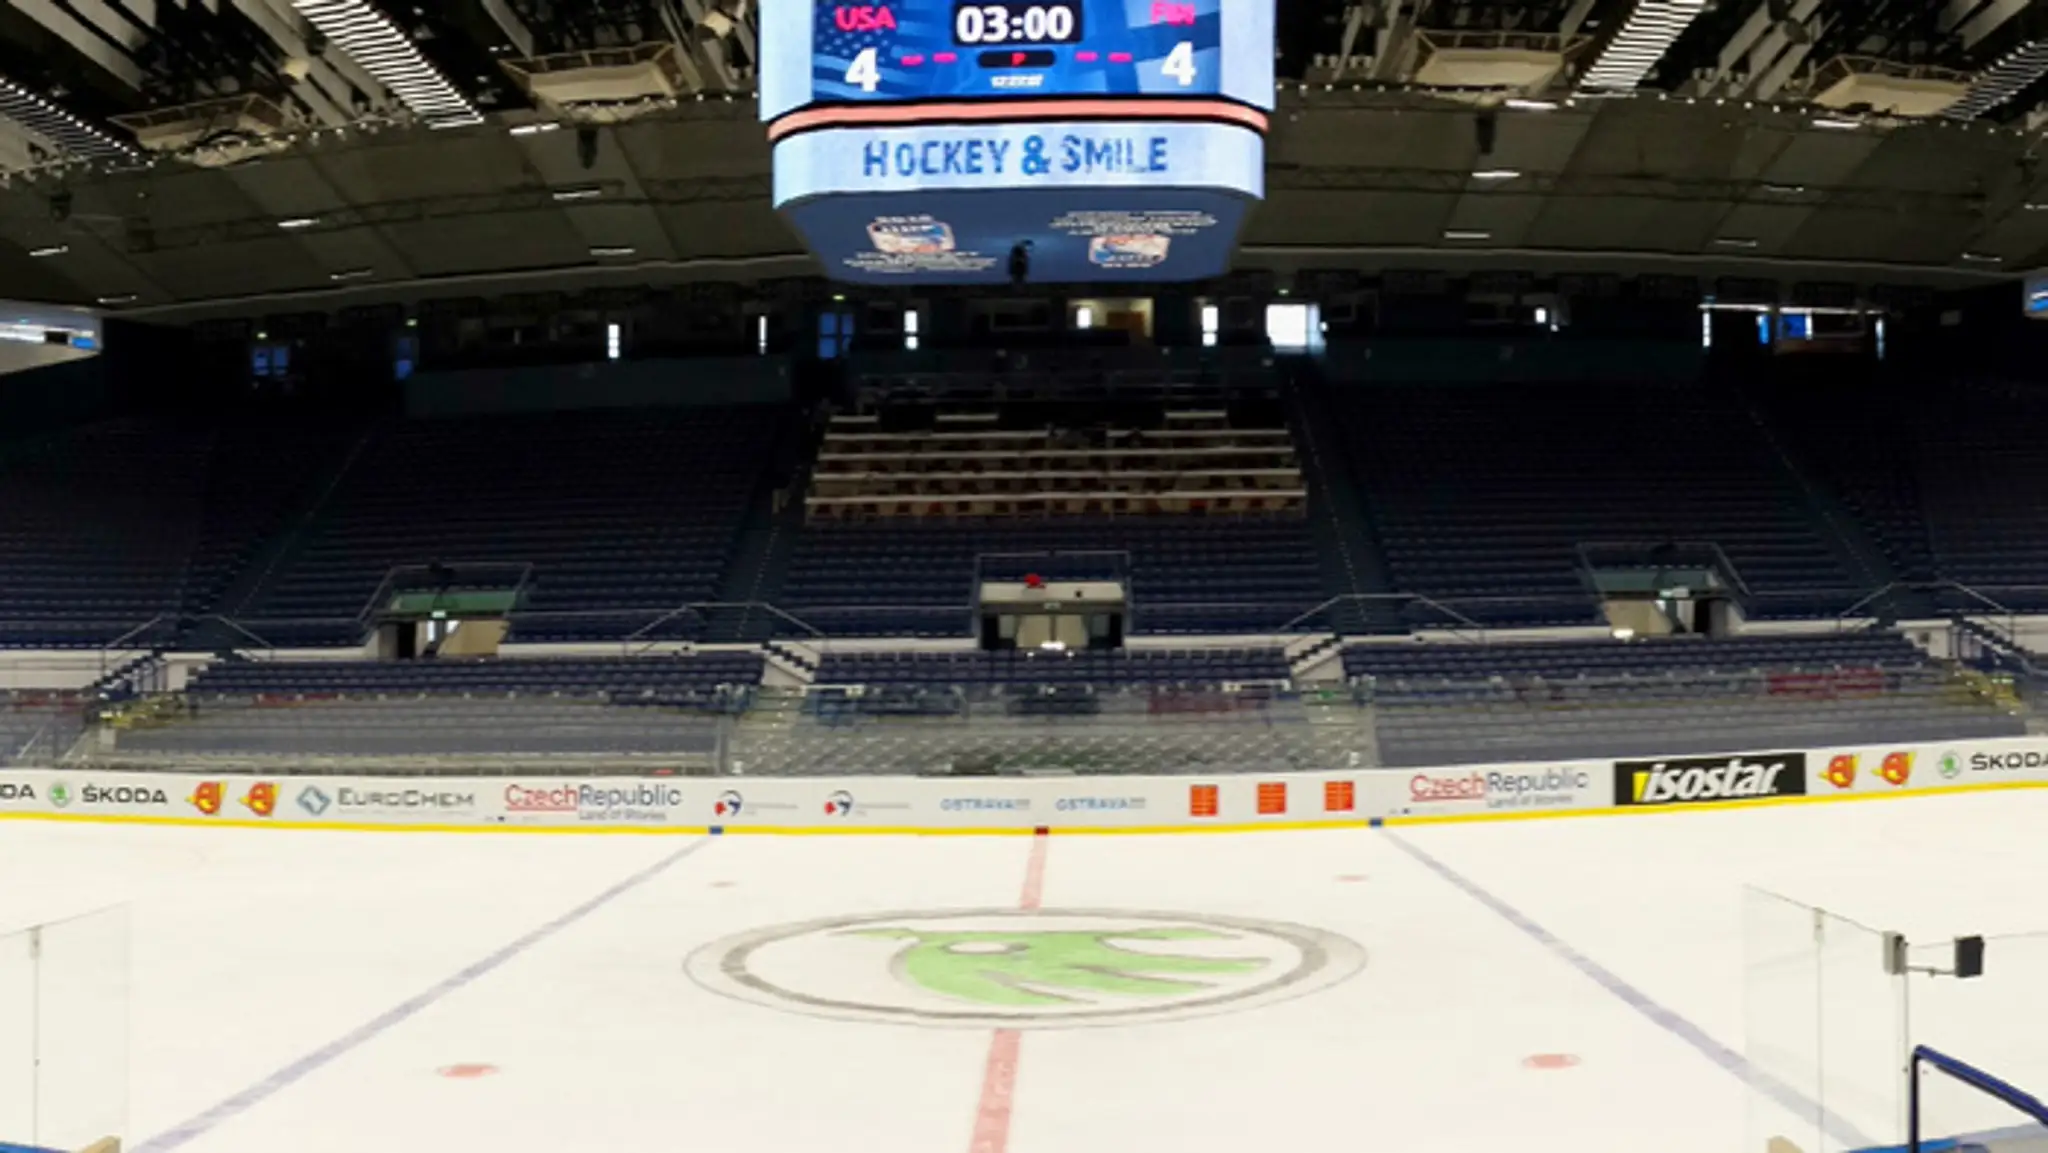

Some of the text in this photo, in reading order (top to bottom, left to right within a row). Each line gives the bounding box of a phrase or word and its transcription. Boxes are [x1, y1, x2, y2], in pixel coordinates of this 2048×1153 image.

[835, 5, 896, 31] USA
[956, 6, 1074, 42] 03:00
[845, 47, 880, 92] 4
[1161, 41, 1196, 86] 4
[863, 135, 1168, 177] HOCKEY & SMILE
[1642, 758, 1785, 802] isostar
